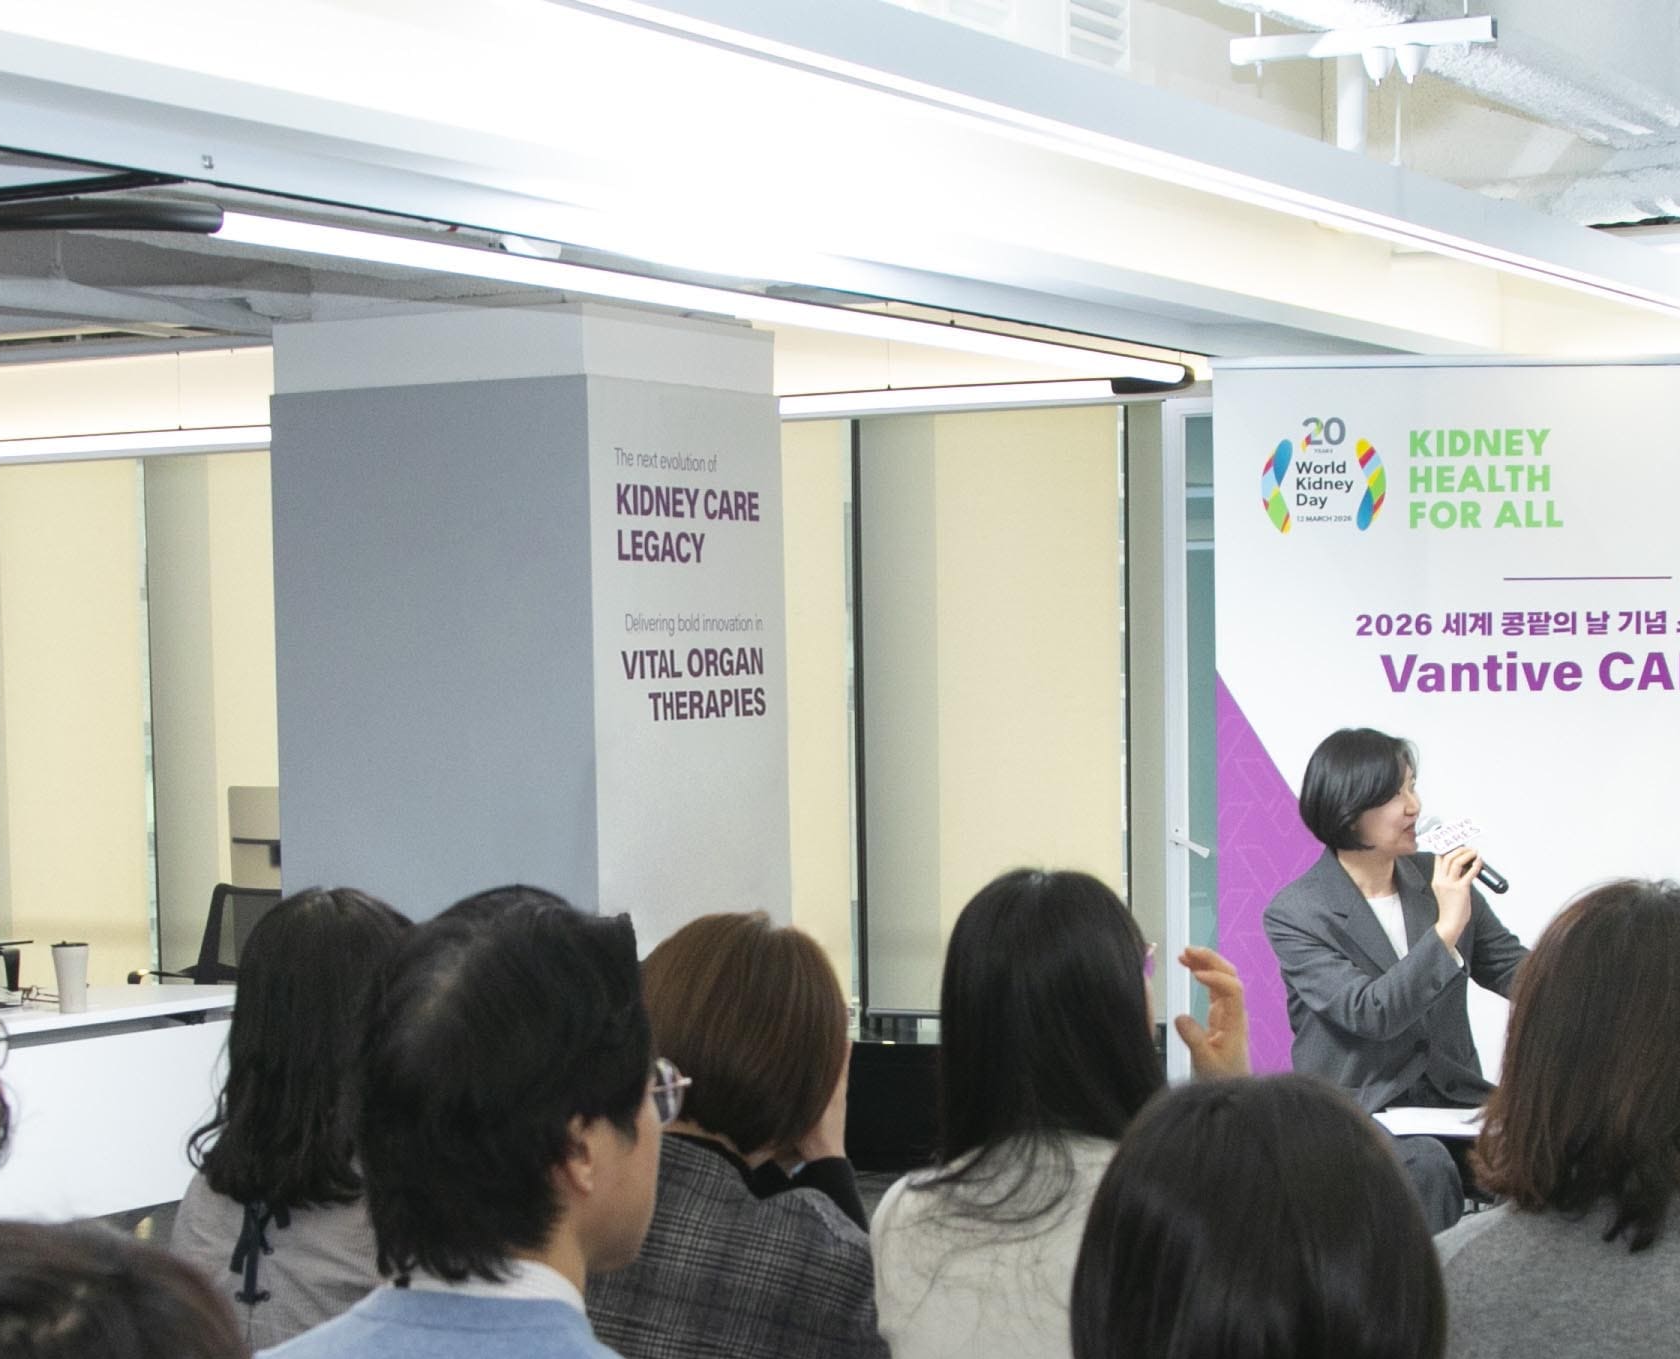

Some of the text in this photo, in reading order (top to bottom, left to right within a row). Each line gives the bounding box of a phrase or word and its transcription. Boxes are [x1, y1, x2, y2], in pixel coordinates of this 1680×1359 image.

[1301, 416, 1346, 449] 20
[1409, 428, 1552, 458] KIDNEY
[614, 448, 717, 472] The next evolution of
[1296, 461, 1347, 474] World
[1296, 477, 1354, 493] Kidney
[1409, 465, 1552, 494] HEALTH
[616, 483, 760, 522] KIDNEY CARE
[1296, 494, 1328, 509] Day
[1409, 500, 1564, 530] FOR ALL
[617, 530, 705, 563] LEGACY
[625, 614, 763, 636] Delivering bold innovation in
[1355, 613, 1433, 636] 2026
[1442, 612, 1493, 637] 세계
[1502, 612, 1578, 636] 콩팥의
[1585, 612, 1609, 636] 날
[1618, 611, 1667, 636] 기념
[621, 647, 764, 680] VITAL ORGAN
[1381, 652, 1583, 694] Vantive
[648, 687, 767, 722] THERAPIES
[1423, 818, 1472, 844] Vantive
